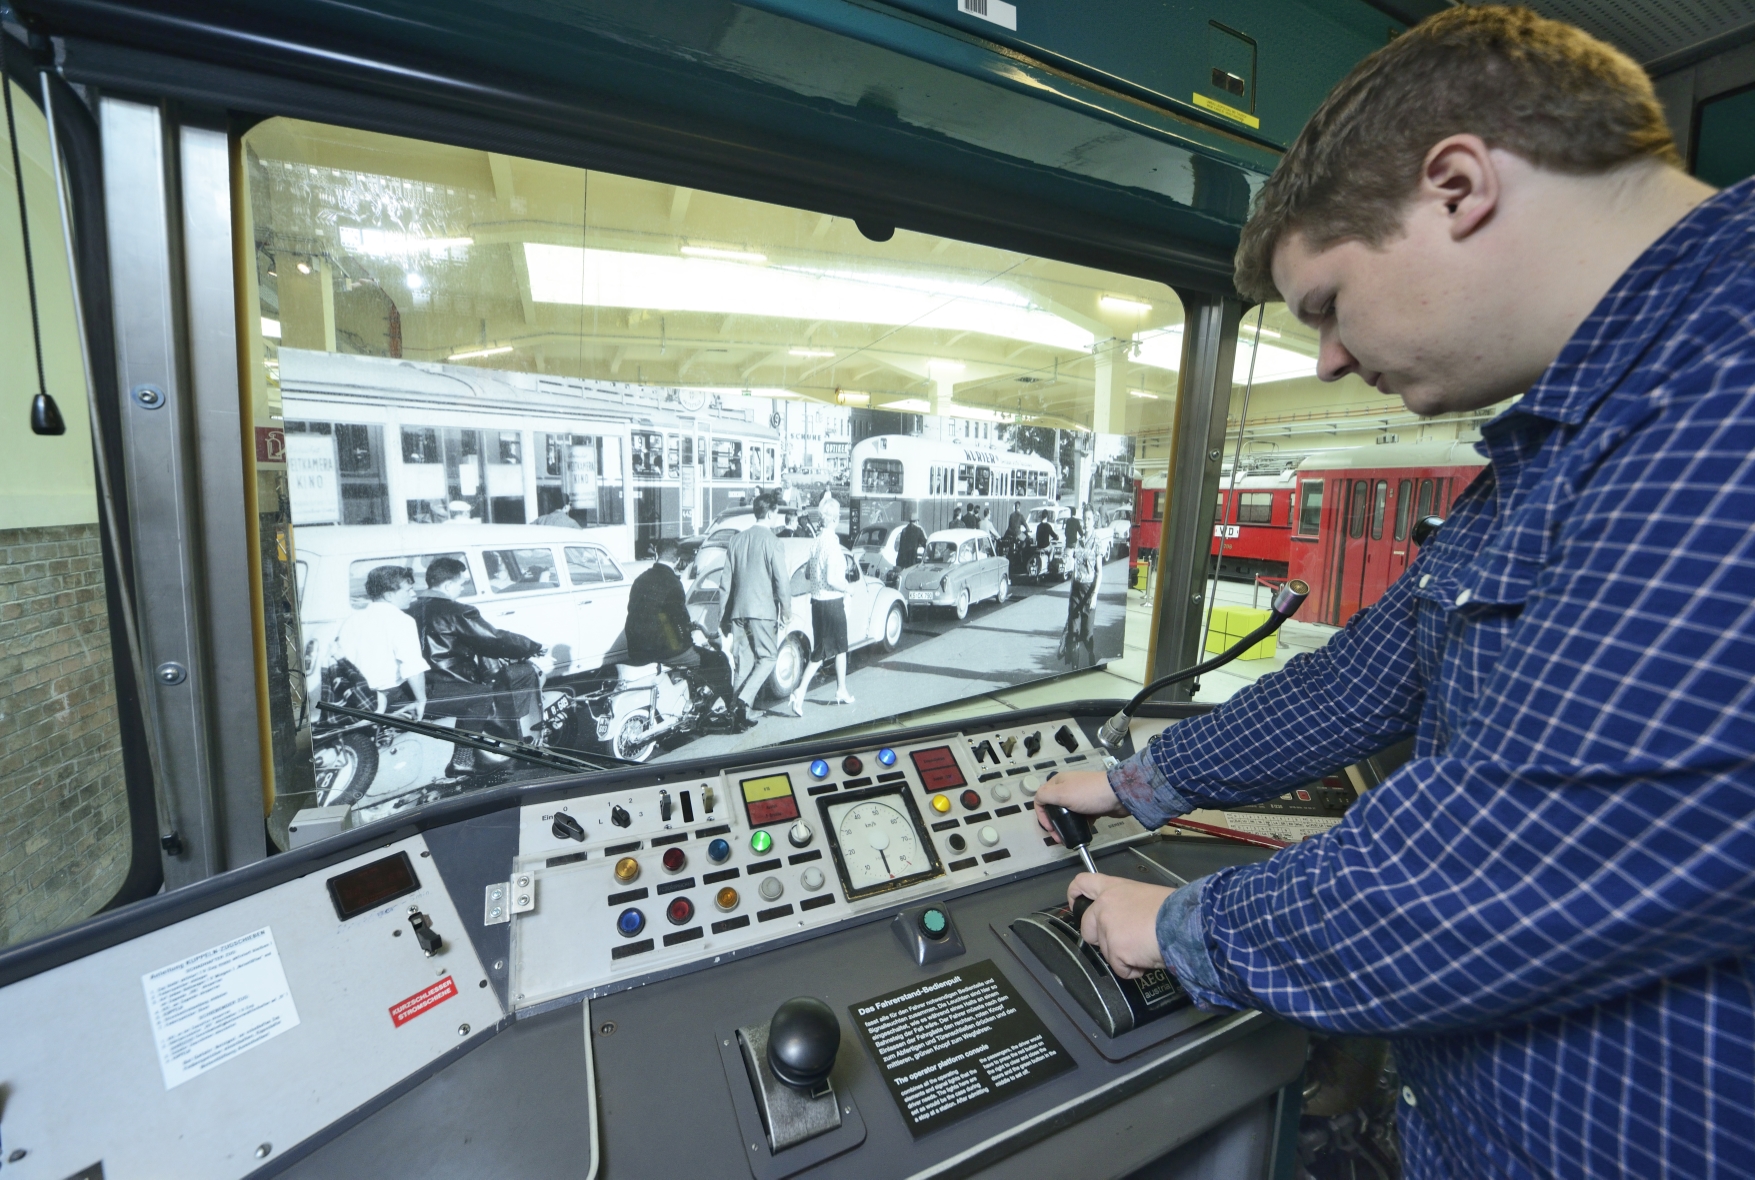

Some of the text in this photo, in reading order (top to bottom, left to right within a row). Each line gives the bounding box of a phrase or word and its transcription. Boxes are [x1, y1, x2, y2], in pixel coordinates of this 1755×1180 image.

[790, 432, 822, 441] SCHUHE
[964, 449, 996, 464] KURIER
[297, 475, 323, 489] KINO
[574, 474, 588, 484] KINO
[392, 979, 452, 1016] KURZSCHLIESSER
[858, 976, 962, 1016] Das Fahrerstand-Bedienpult
[1141, 970, 1165, 989] AEG
[1145, 983, 1171, 998] austria
[398, 987, 451, 1020] STROMSCHIENE
[865, 1018, 879, 1027] fasst
[908, 1003, 925, 1012] Fahrer
[926, 992, 958, 1006] notwendigen
[957, 982, 984, 994] Bedienteile
[868, 1017, 908, 1034] Signalleuchten
[908, 1007, 938, 1020] zusammen.
[946, 994, 970, 1006] Leuchten
[872, 1024, 910, 1040] eingeschaltet,
[927, 1008, 950, 1020] während
[984, 991, 999, 1000] einem
[875, 1034, 904, 1048] Bahnsteig
[949, 1011, 966, 1020] Fahrer
[966, 1004, 985, 1014] müsste
[879, 1041, 906, 1055] Einlassen
[916, 1028, 943, 1040] Fahrgäste
[954, 1016, 976, 1026] rechten,
[988, 1004, 1004, 1013] Knopf
[883, 1054, 896, 1062] zum
[896, 1043, 925, 1057] Abfertigen
[925, 1037, 937, 1046] und
[936, 1024, 976, 1041] Türenschließen
[975, 1016, 996, 1026] drücken
[887, 1026, 992, 1069] mittleren, grünen Knopf zum Wegfahren.
[894, 1044, 989, 1085] The operator platform console
